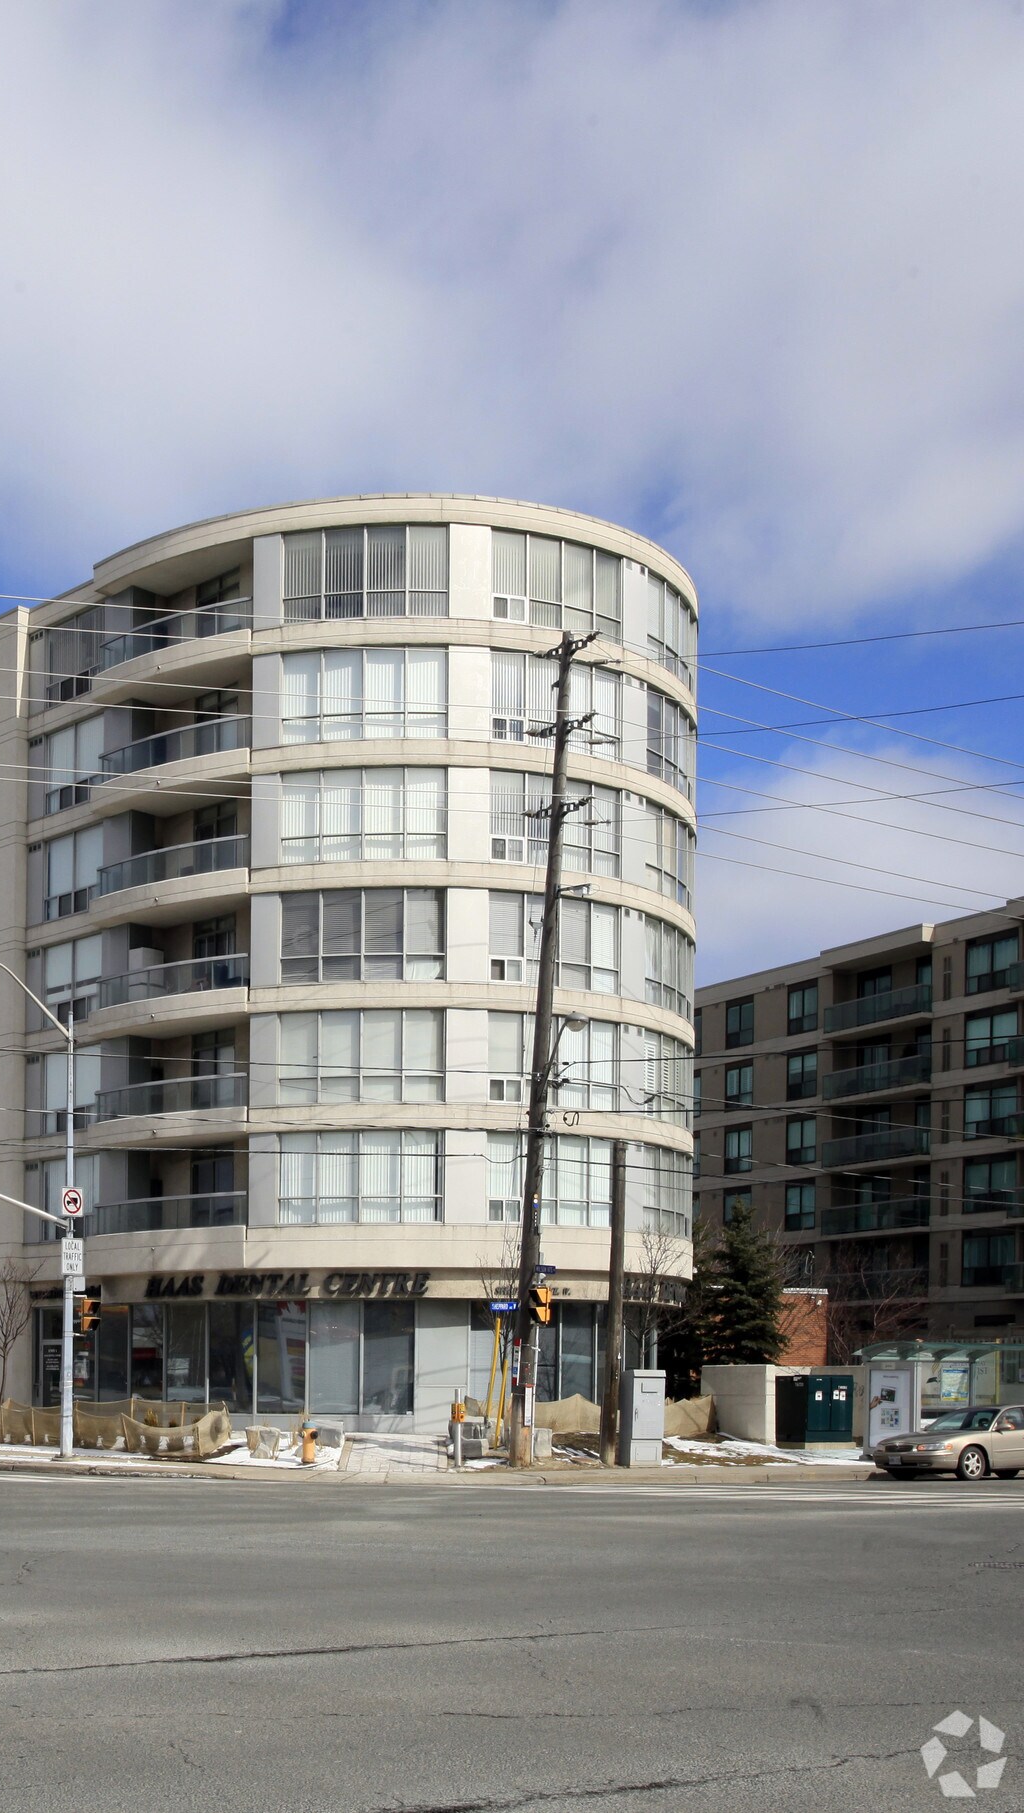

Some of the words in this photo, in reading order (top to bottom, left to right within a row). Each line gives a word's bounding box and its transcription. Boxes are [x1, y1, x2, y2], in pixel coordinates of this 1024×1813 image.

[65, 1241, 80, 1251] LOCAL
[63, 1252, 82, 1261] TRAFFIC
[66, 1263, 79, 1271] ONLY
[144, 1275, 205, 1297] HAAS
[214, 1273, 312, 1296] DENTAL
[325, 1272, 431, 1295] CENTRE
